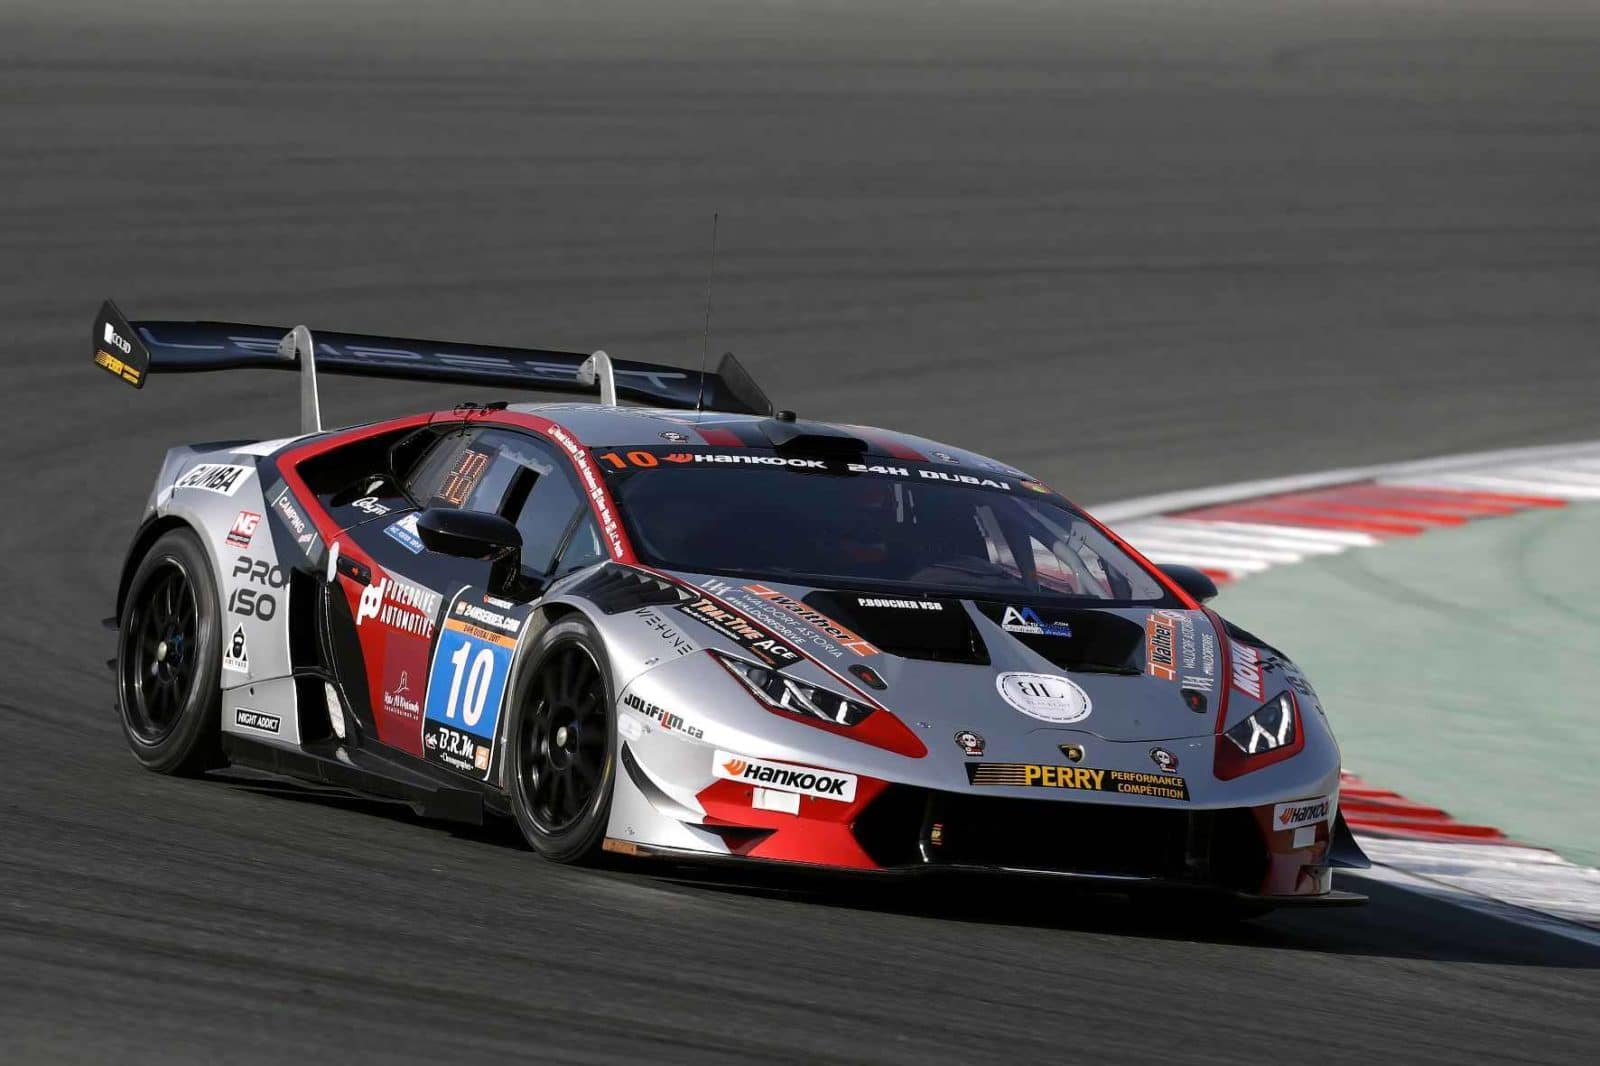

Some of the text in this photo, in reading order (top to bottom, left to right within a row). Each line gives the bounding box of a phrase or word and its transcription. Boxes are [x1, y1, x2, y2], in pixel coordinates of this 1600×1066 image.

[601, 450, 659, 469] 10
[847, 463, 1012, 490] 24H DUBAI
[278, 496, 306, 534] CAMPING
[232, 555, 284, 589] PRO
[228, 587, 276, 622] ISO
[384, 579, 436, 614] PUREDRIVE
[857, 597, 918, 611] P.BOUCHER
[379, 602, 434, 639] AUTOMOTIVE
[690, 598, 765, 640] TRACTIVE
[751, 639, 798, 660] ACE
[771, 596, 852, 640] Walther
[1151, 623, 1173, 665] Walther
[446, 641, 494, 727] 10
[237, 711, 280, 730] NIGHT ADDICT
[743, 764, 850, 796] Hankook
[1024, 765, 1105, 790] PERRY
[1111, 771, 1185, 787] PERFORMANCE
